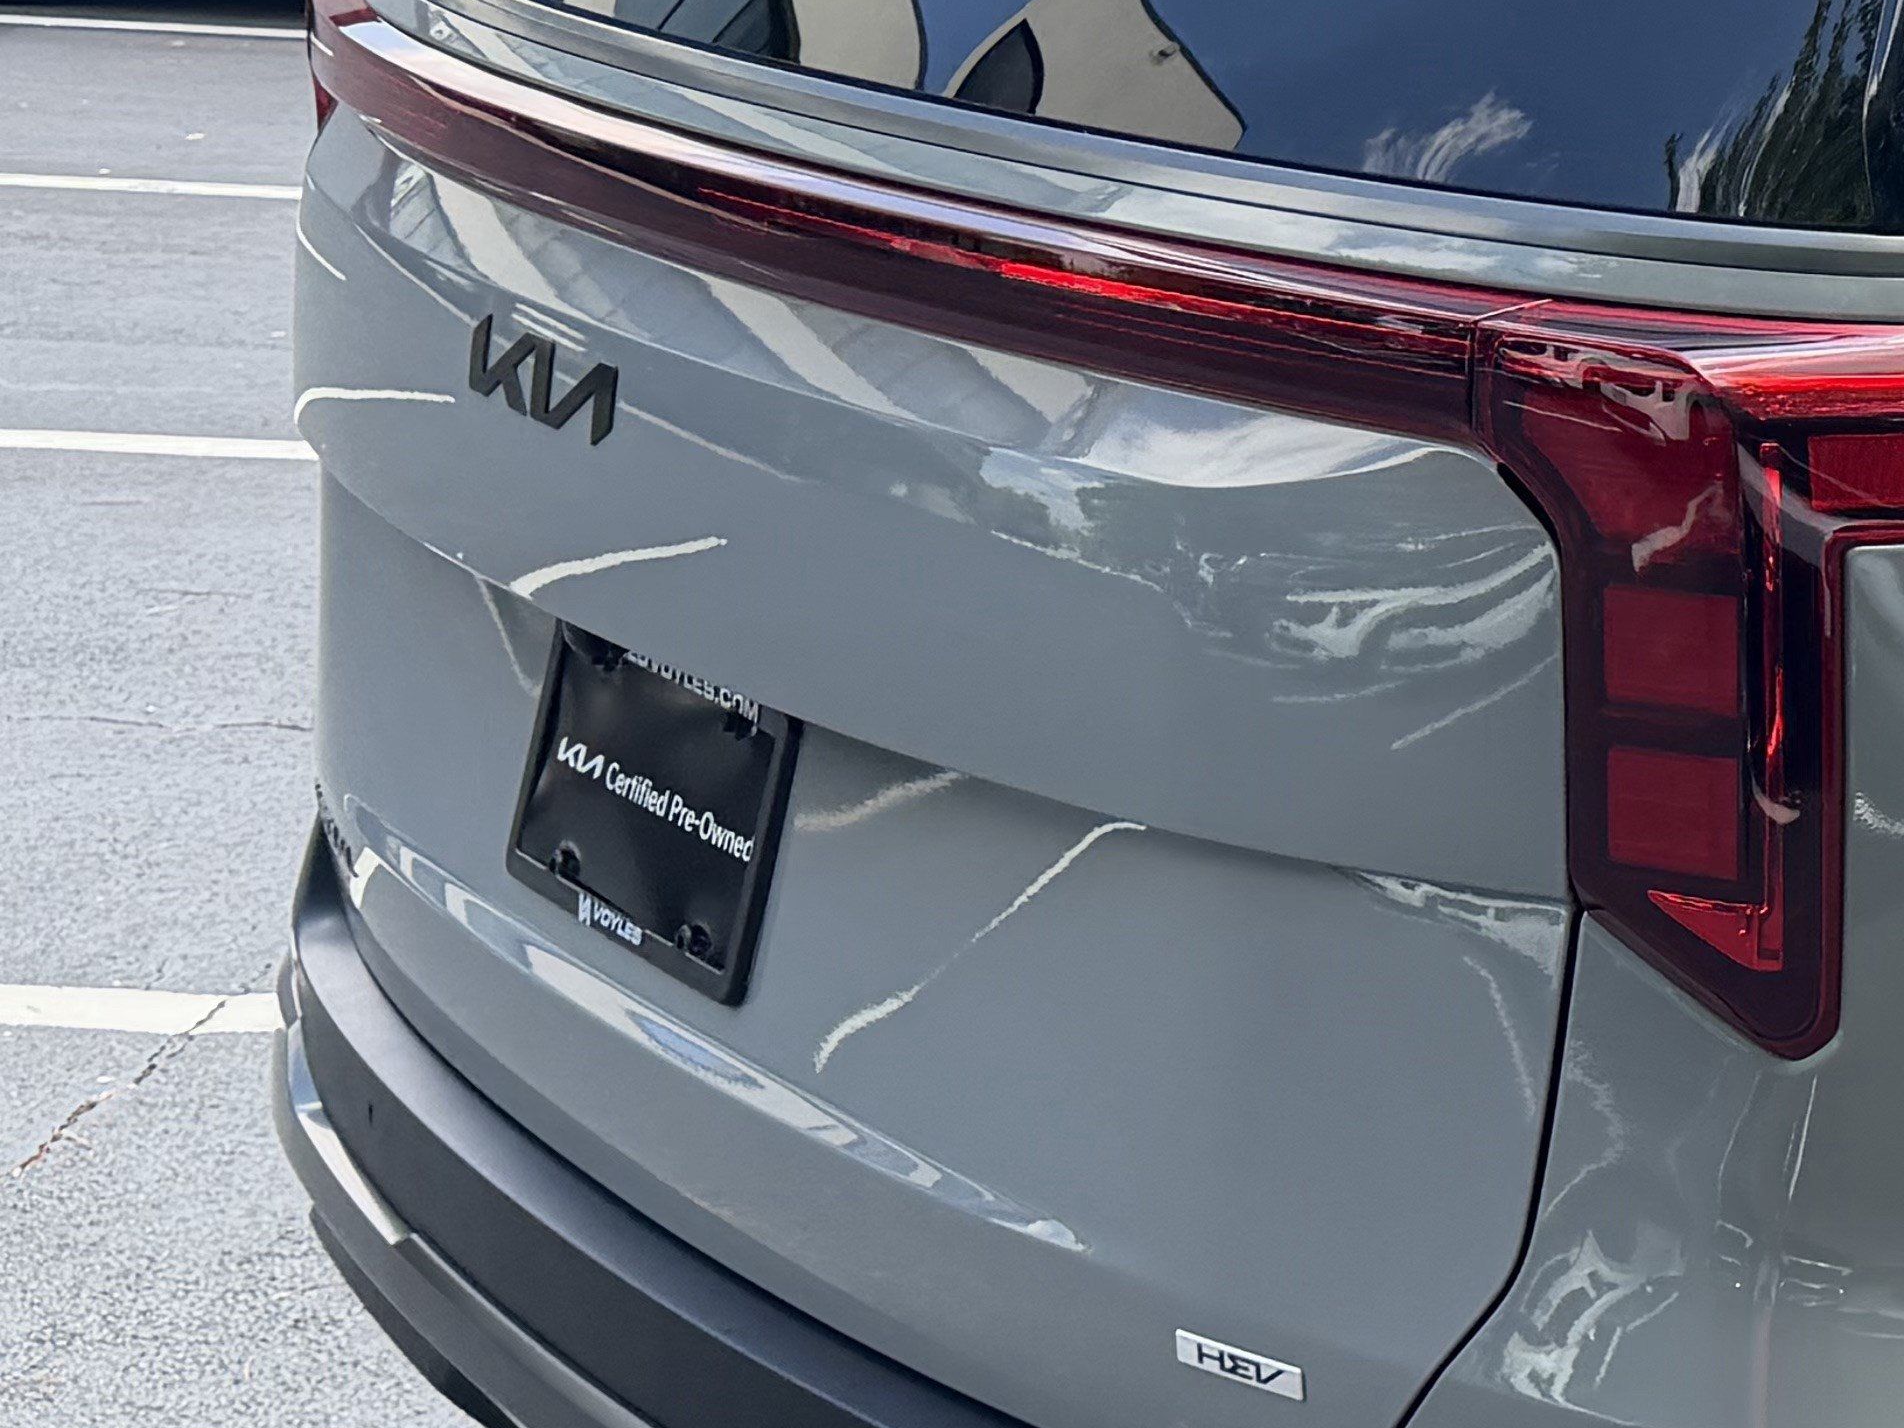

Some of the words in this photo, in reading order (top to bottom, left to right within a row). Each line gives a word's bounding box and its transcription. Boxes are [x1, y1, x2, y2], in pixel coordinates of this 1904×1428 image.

[469, 313, 619, 447] KIA
[557, 736, 605, 779] KIA
[605, 762, 670, 818] Certified
[1197, 1342, 1285, 1385] HEV
